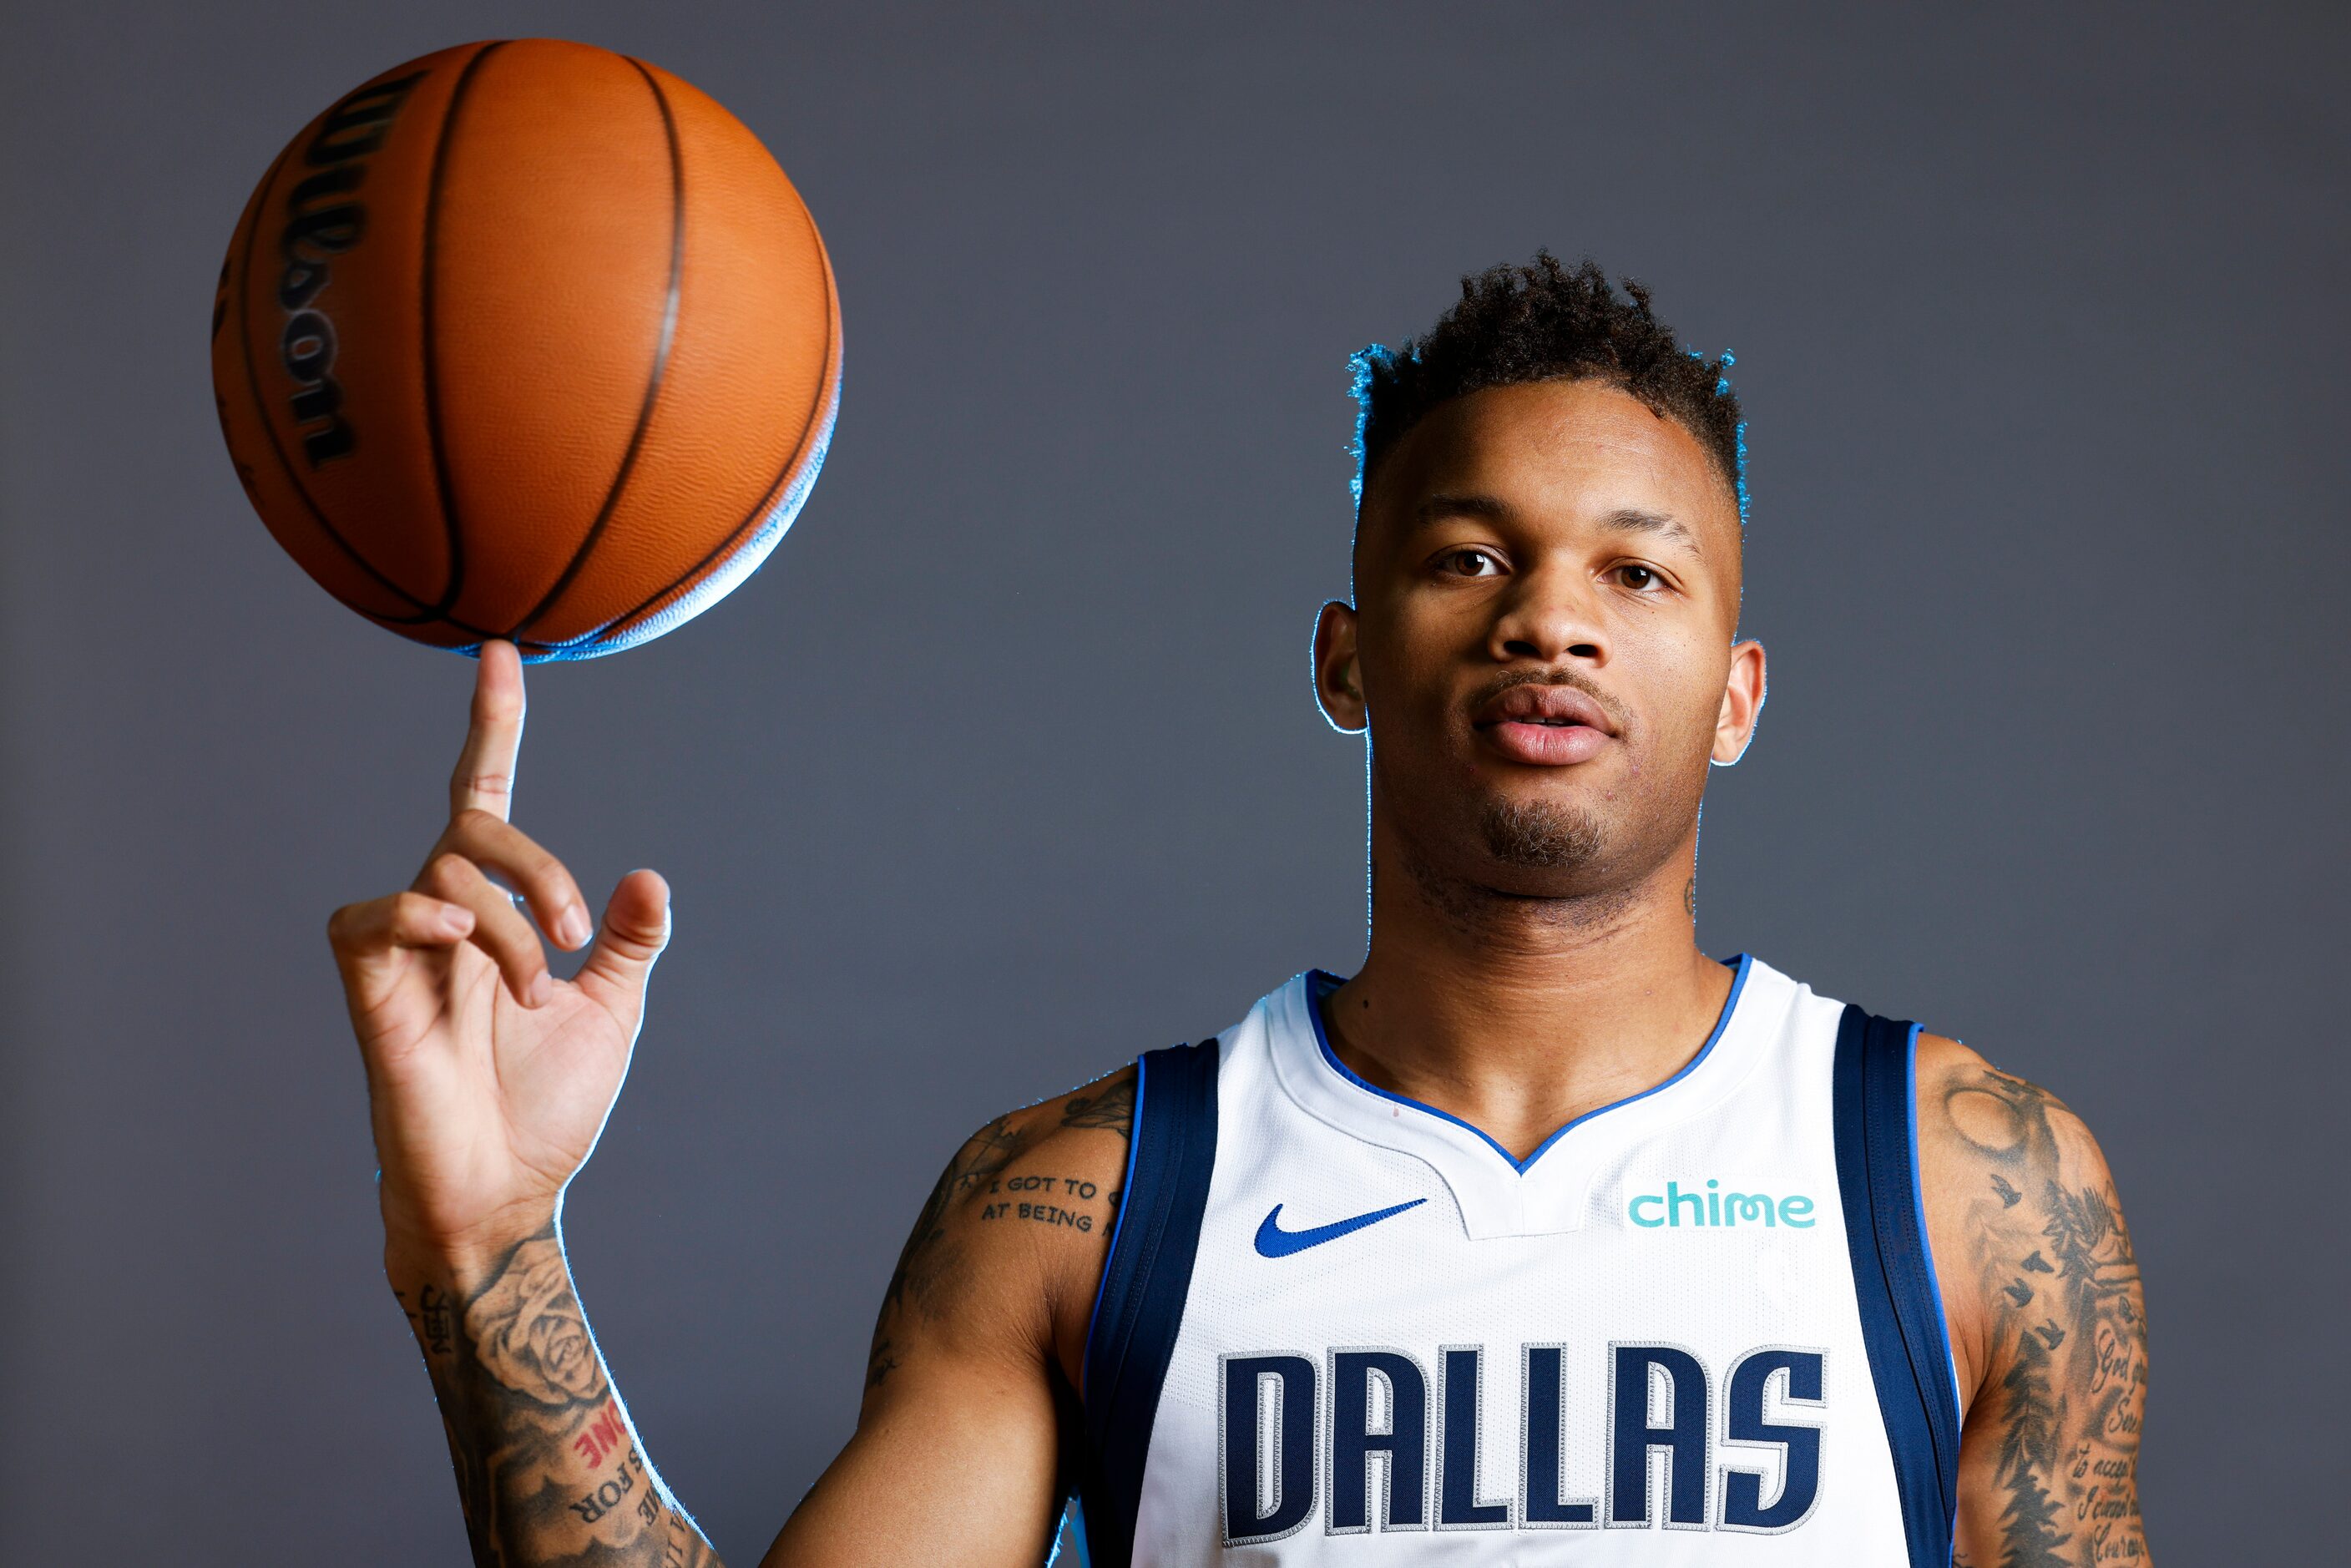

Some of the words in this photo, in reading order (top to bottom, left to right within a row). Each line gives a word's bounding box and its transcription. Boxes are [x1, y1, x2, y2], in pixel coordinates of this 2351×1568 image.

[988, 1179, 1001, 1194] I
[1007, 1176, 1057, 1192] GOT
[1064, 1179, 1097, 1201] TO
[1628, 1179, 1816, 1228] chime
[981, 1202, 1011, 1221] AT
[1018, 1202, 1093, 1233] BEING
[2091, 1328, 2131, 1393] God
[1216, 1340, 1832, 1547] DALLAS
[569, 1462, 635, 1524] FOR
